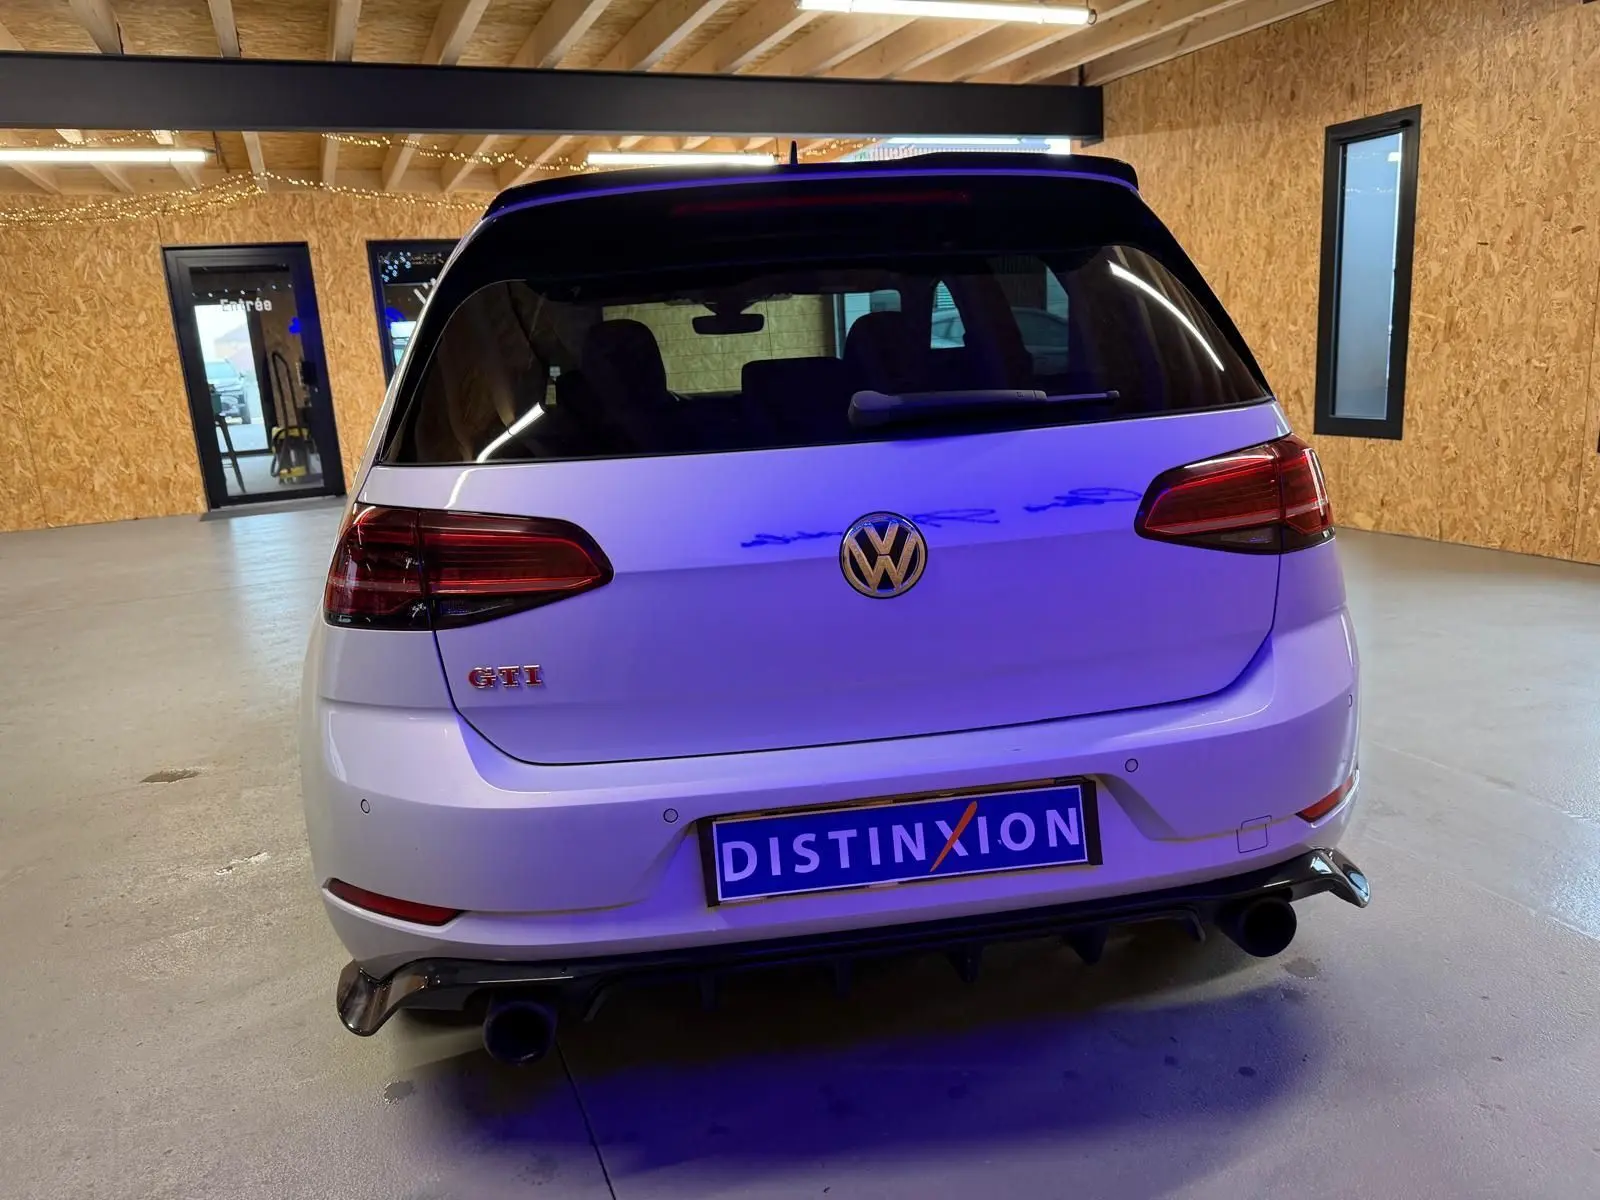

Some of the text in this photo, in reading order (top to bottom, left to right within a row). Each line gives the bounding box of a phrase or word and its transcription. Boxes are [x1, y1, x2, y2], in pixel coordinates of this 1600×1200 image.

[220, 297, 273, 312] Entrée
[468, 664, 542, 689] GTI
[721, 801, 1080, 882] DISTINXION
